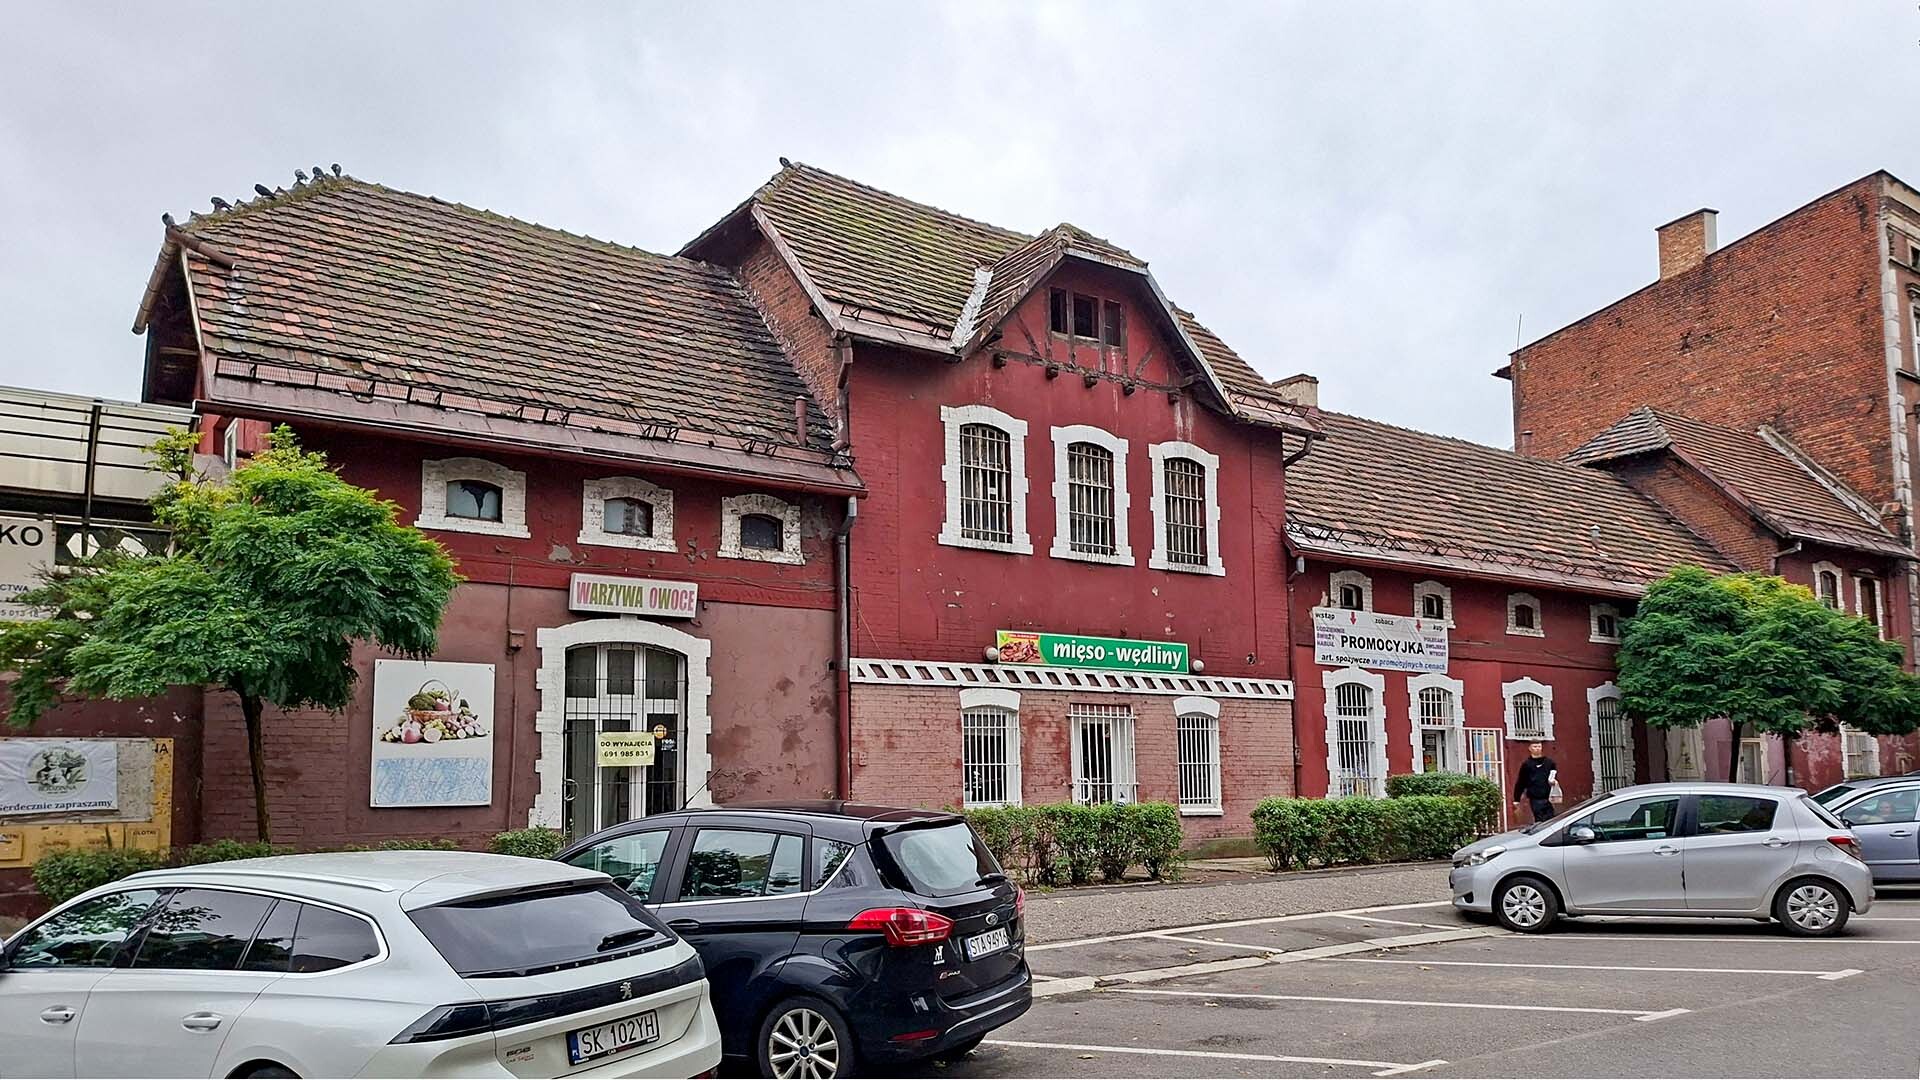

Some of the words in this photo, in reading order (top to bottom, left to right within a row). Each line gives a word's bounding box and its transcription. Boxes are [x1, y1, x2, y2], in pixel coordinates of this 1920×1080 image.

[576, 581, 643, 608] WARZYWA
[649, 587, 695, 611] OWOCE
[1341, 635, 1425, 655] PROMOCYJKA
[612, 740, 652, 748] WYNAJĘCIA
[55, 799, 113, 810] zapraszamy
[970, 938, 987, 955] STA
[581, 1028, 604, 1054] SK
[610, 1015, 655, 1046] 102YH
